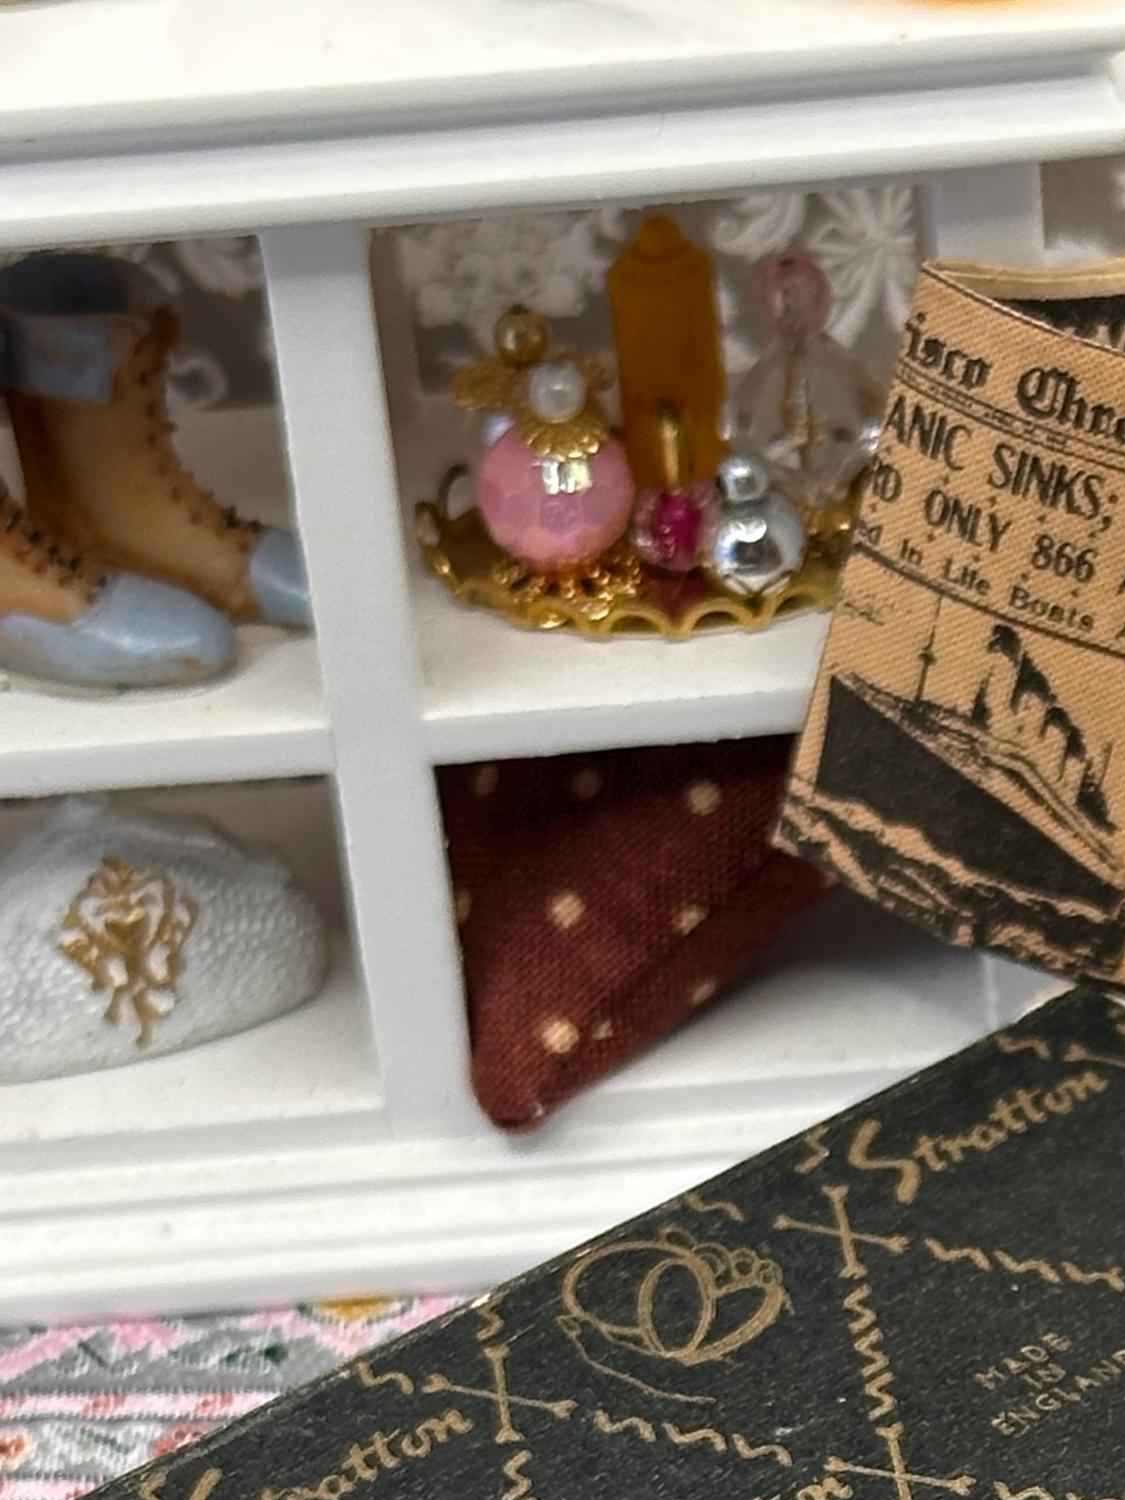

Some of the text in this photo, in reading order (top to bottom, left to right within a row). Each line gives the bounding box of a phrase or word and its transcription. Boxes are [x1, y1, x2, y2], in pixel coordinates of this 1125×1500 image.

[905, 311, 991, 391] isco
[884, 394, 971, 471] ANIC
[987, 442, 1119, 531] SINKS;
[923, 489, 1012, 551] ONLY
[1031, 533, 1098, 583] 866
[1008, 583, 1095, 633] Boats
[849, 1069, 1108, 1204] Stratton
[974, 1332, 1072, 1390] MADE
[1022, 1362, 1067, 1390] IN
